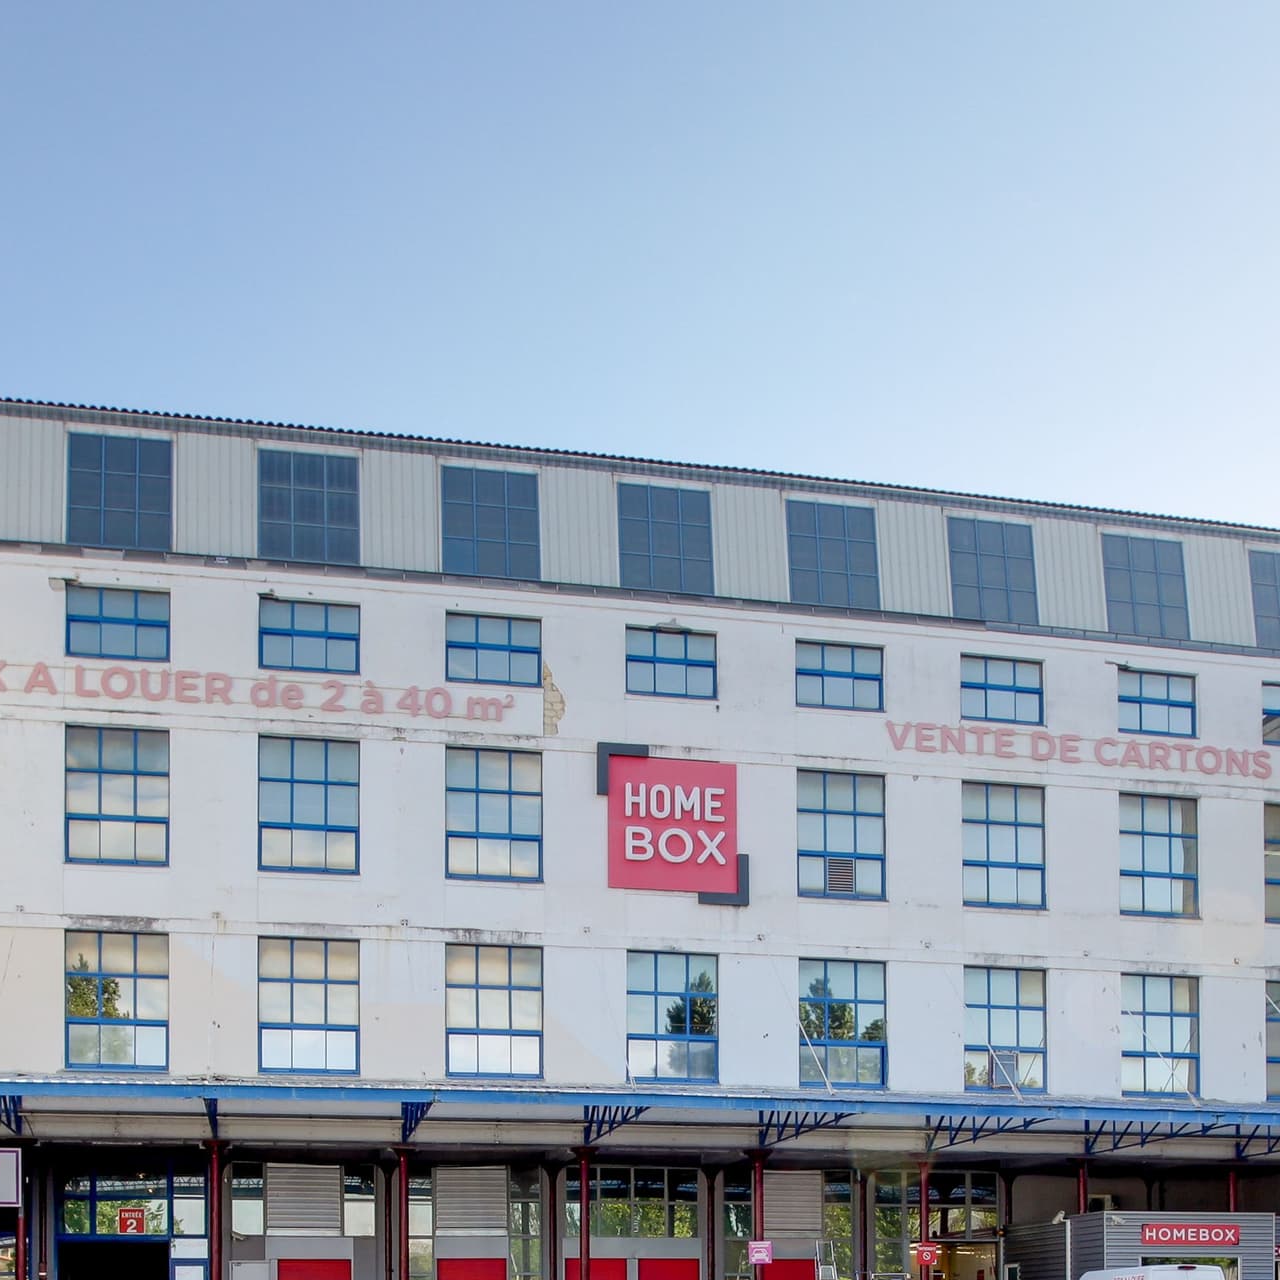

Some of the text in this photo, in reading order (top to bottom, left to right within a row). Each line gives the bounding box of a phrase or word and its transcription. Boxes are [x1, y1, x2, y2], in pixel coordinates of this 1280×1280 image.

[23, 661, 57, 695] A
[74, 664, 233, 706] LOUER
[249, 674, 305, 711] de
[320, 679, 346, 713] 2
[359, 679, 385, 715] à
[395, 685, 453, 719] 40
[885, 719, 1273, 780] VENTE DE CARTONS
[624, 781, 726, 822] HOME
[624, 825, 727, 865] BOX
[126, 1219, 138, 1233] 2
[1145, 1228, 1236, 1242] HOMEBOX
